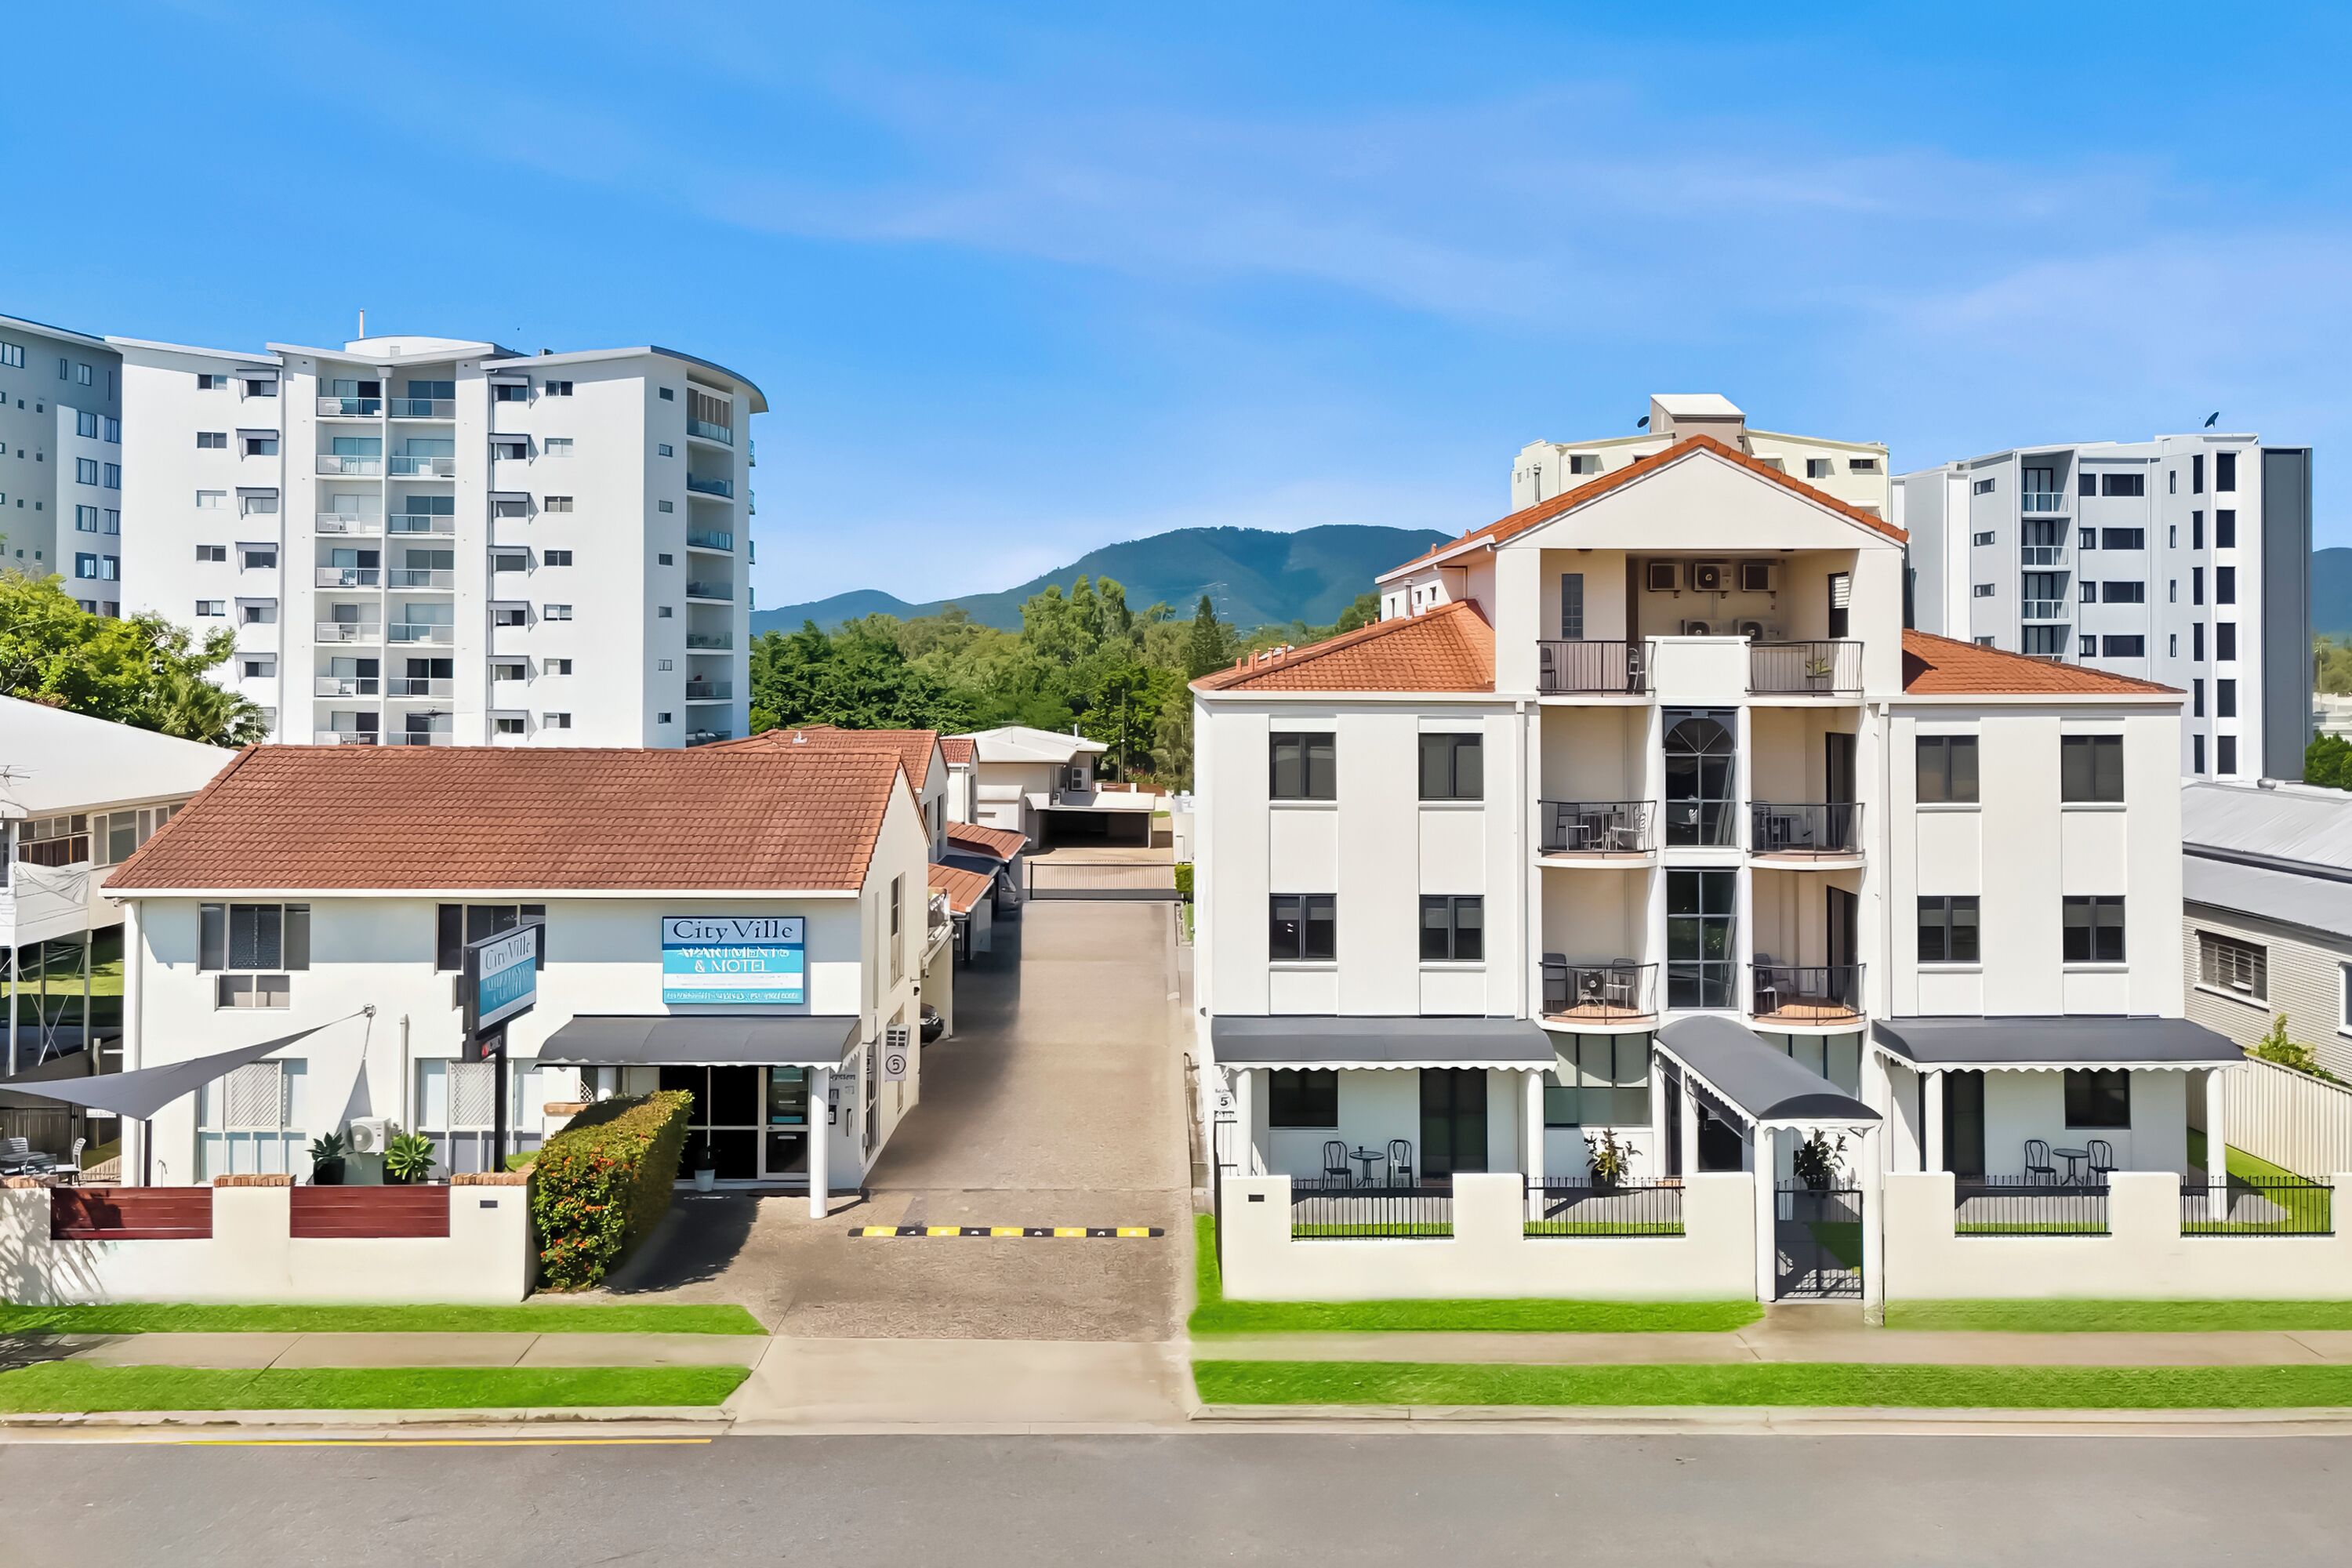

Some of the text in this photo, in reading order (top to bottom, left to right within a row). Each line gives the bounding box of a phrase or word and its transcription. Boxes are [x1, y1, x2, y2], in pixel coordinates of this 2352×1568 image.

[711, 958, 771, 973] MOTEL
[892, 1058, 900, 1071] 5
[1220, 1096, 1229, 1106] 5
